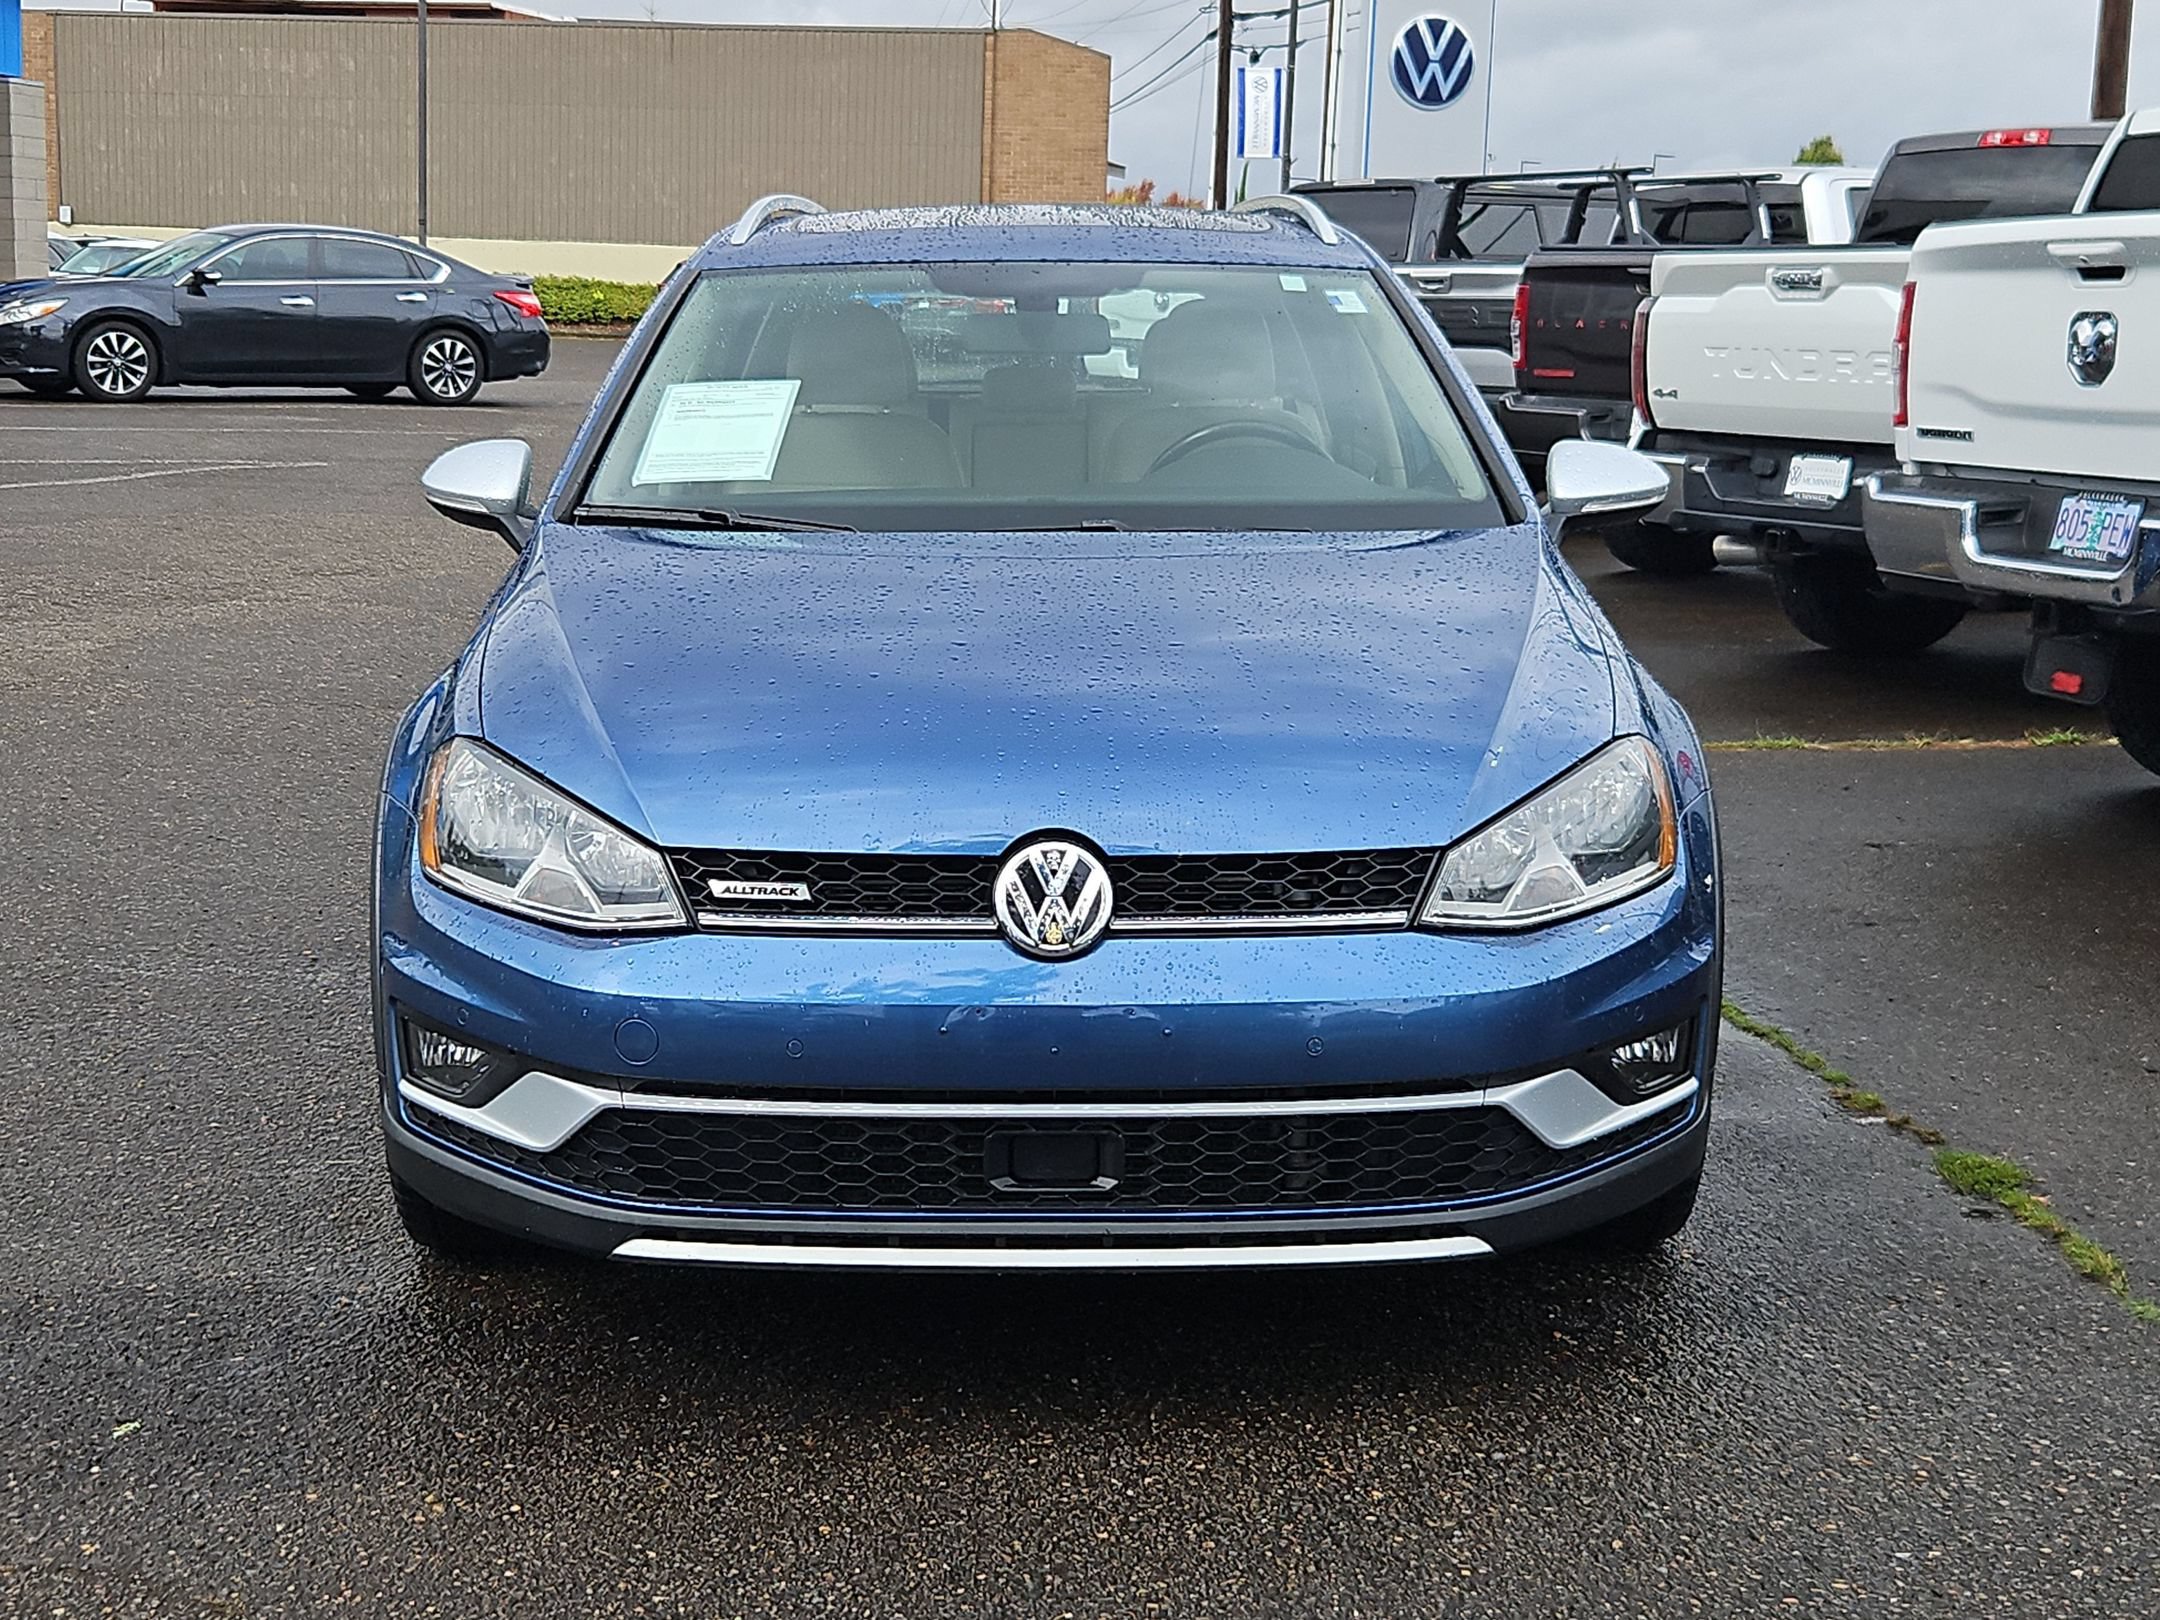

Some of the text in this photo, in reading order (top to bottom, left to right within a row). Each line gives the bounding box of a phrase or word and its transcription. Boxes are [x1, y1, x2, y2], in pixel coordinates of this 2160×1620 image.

[1393, 15, 1474, 106] VW
[1703, 346, 1896, 385] TUNDRA
[2056, 507, 2136, 549] 805 PEW
[721, 885, 799, 897] ALLTRACK
[996, 842, 1111, 952] VW
